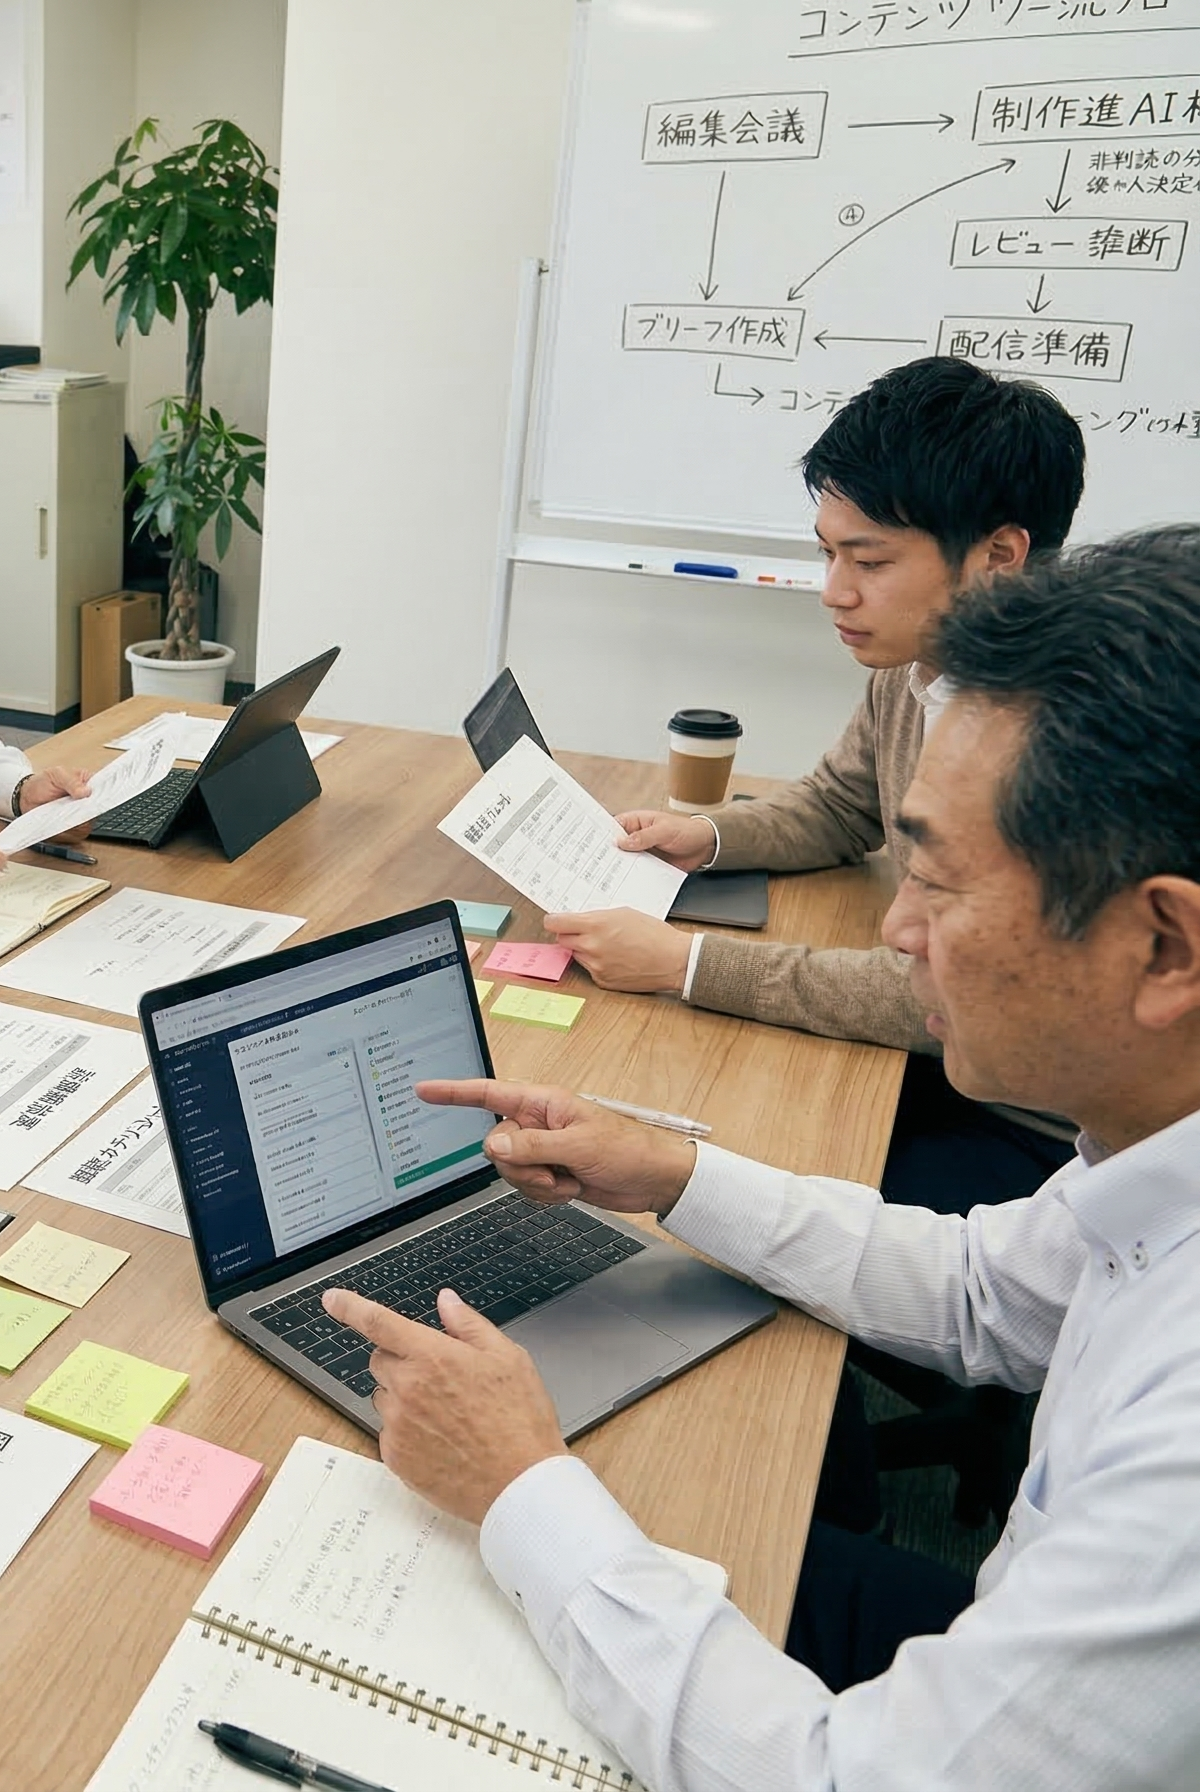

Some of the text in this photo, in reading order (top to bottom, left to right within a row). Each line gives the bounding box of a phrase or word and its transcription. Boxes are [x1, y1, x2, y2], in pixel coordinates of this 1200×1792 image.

[656, 106, 806, 148] 編集会議
[637, 312, 789, 348] ブリーフ作成
[949, 327, 1111, 368] 配信準備
